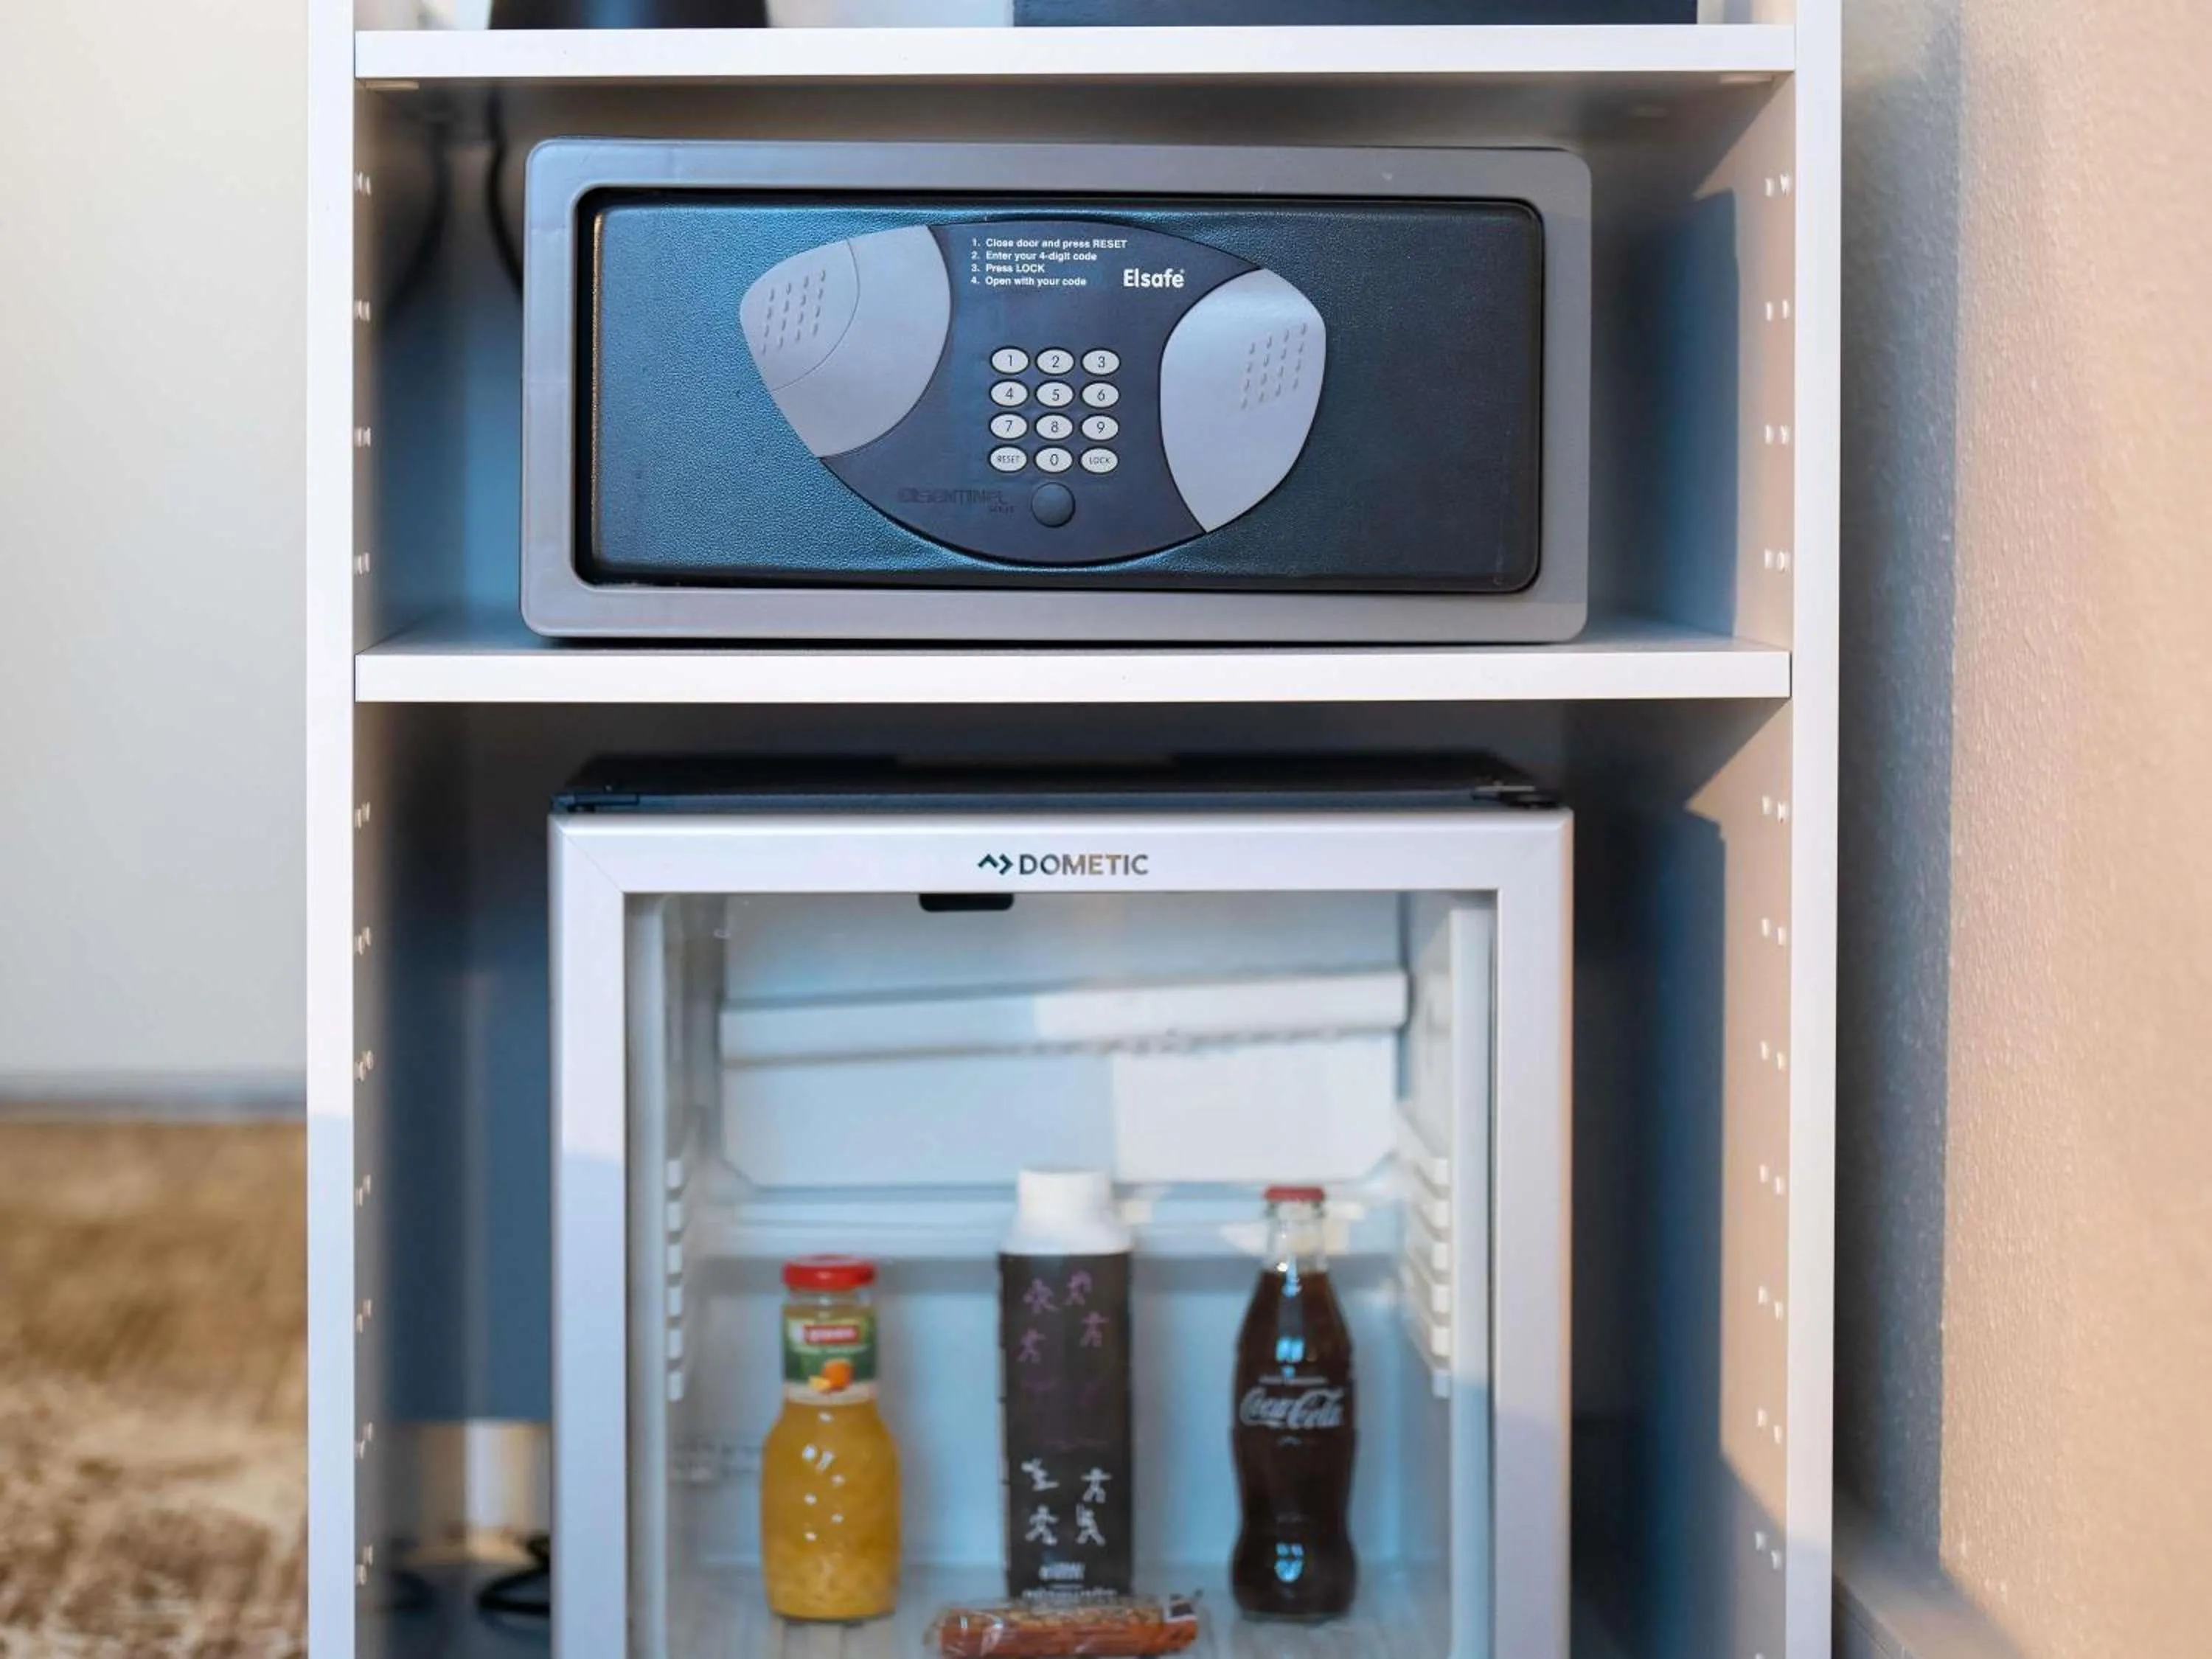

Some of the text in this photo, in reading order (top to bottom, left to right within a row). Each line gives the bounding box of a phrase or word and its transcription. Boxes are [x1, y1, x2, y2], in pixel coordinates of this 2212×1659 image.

[971, 238, 1127, 250] 1. Close door and press RESET
[971, 251, 1098, 262] 2. Enter your 4-digit code
[971, 264, 1046, 273] 3. Press LOCK
[970, 276, 1087, 287] 4. Open with your code
[1122, 268, 1185, 288] Elsafe
[1008, 354, 1013, 366] 1
[1051, 355, 1060, 368] 2
[1098, 355, 1105, 368] 3
[1005, 387, 1014, 400] 4
[1051, 389, 1060, 402] 5
[1096, 389, 1105, 402] 6
[1005, 420, 1013, 434] 7
[1051, 421, 1059, 434] 8
[1096, 421, 1105, 434] 9
[996, 455, 1020, 464] RESET
[1049, 453, 1059, 466] 0
[1089, 456, 1110, 465] LOCK
[1019, 853, 1149, 876] DOMETIC
